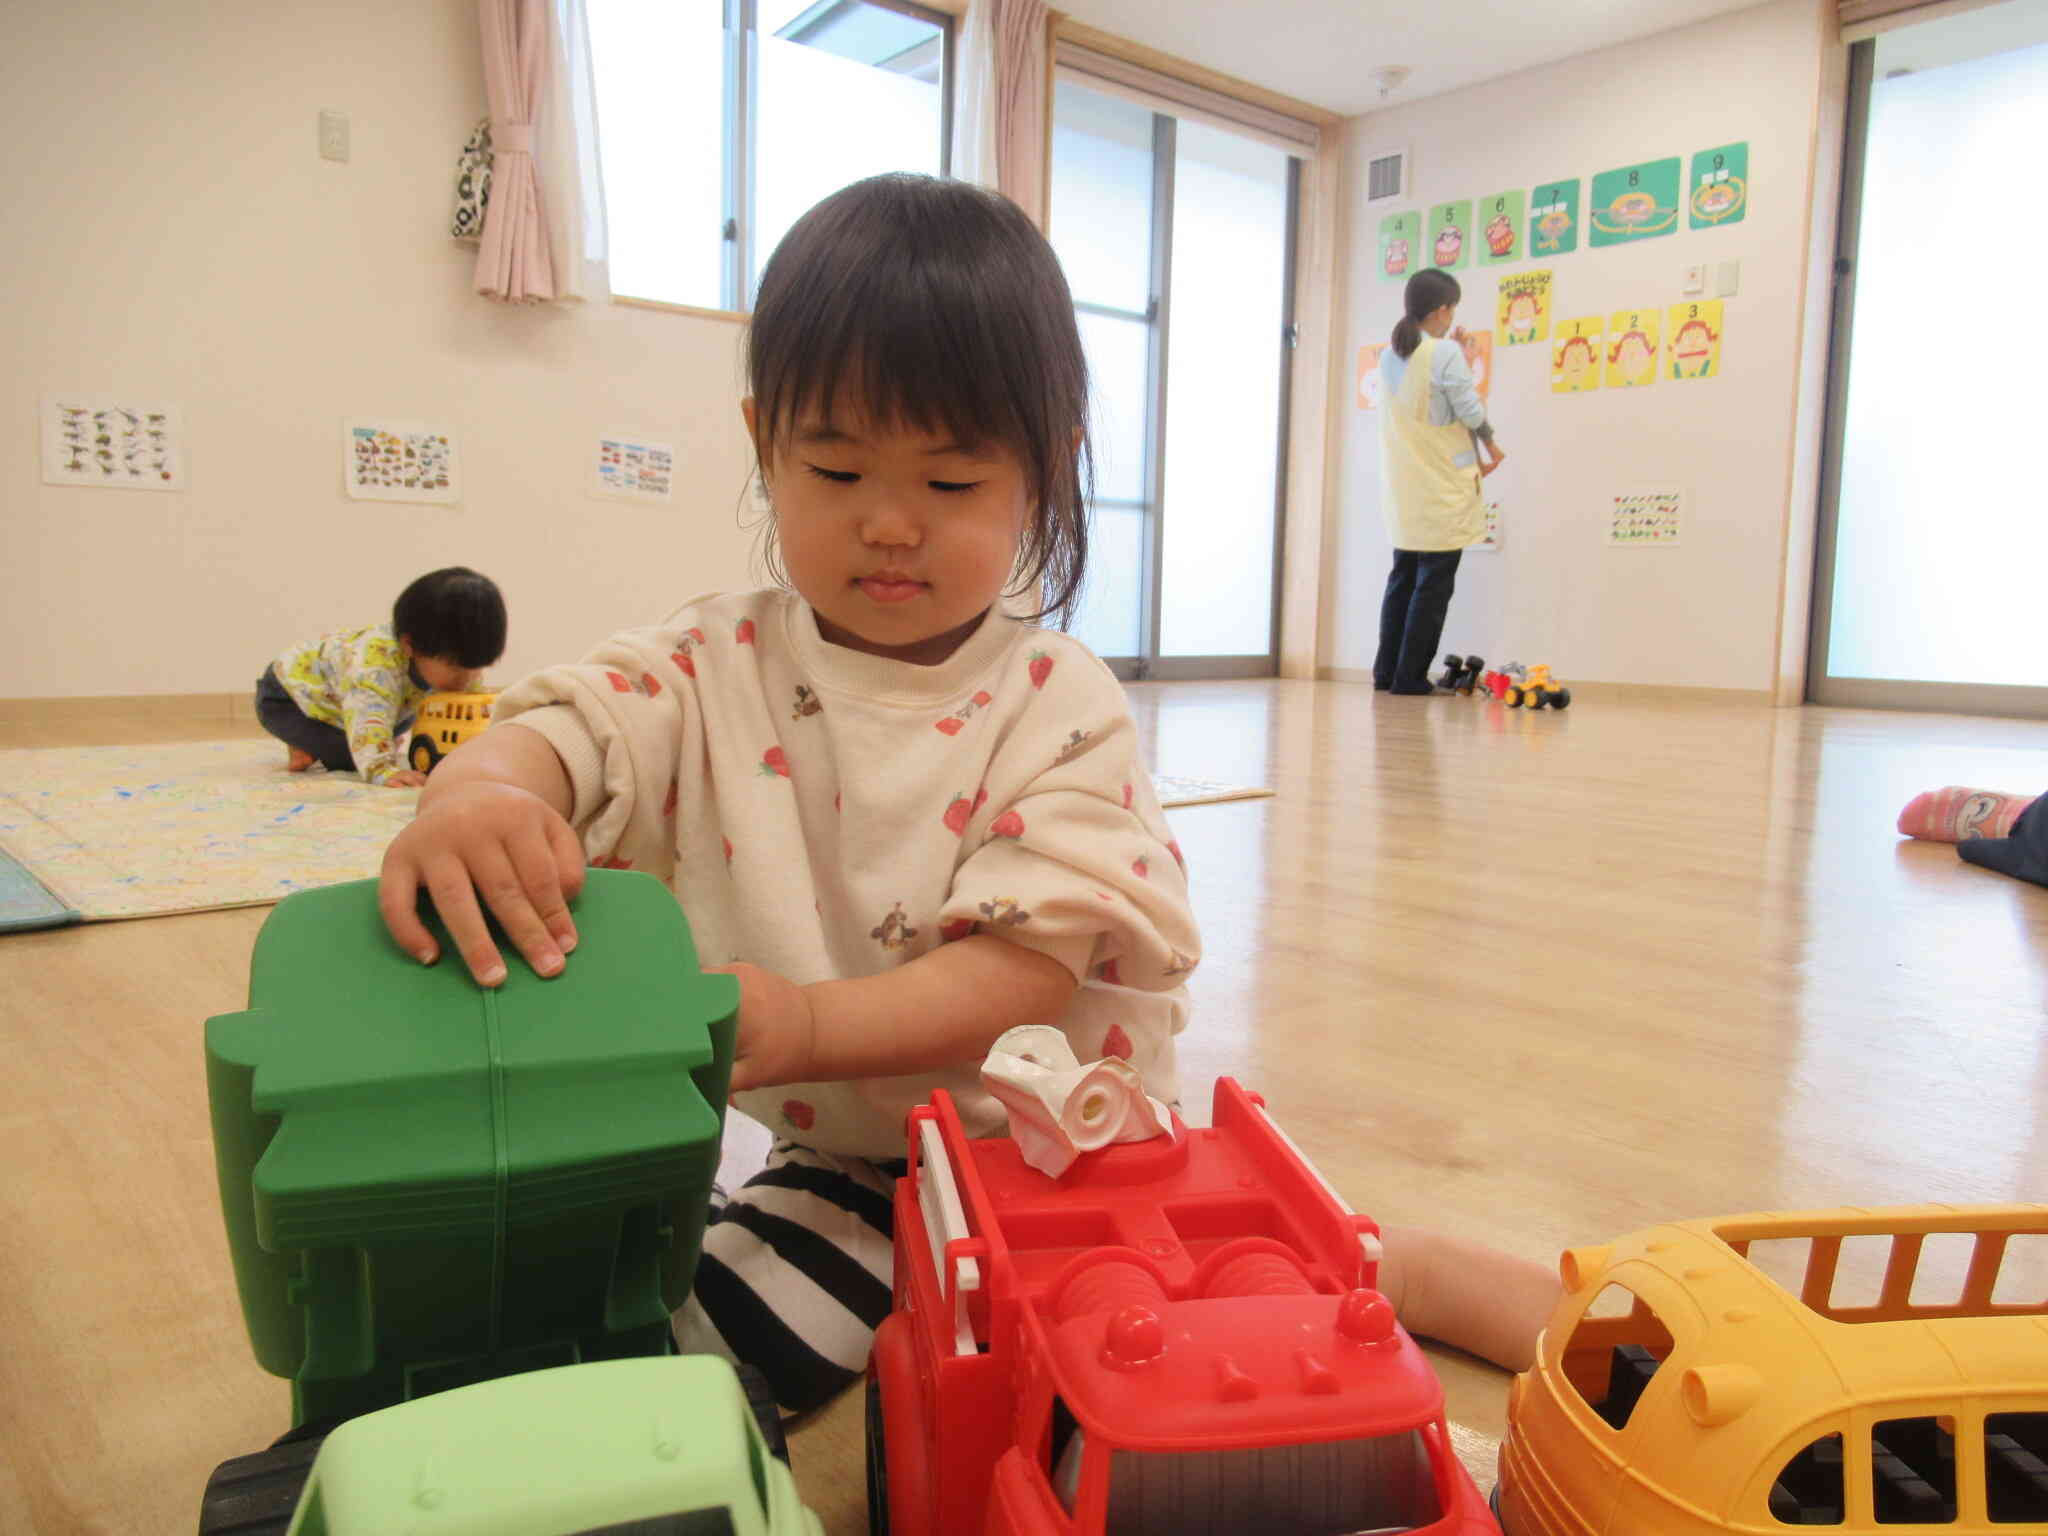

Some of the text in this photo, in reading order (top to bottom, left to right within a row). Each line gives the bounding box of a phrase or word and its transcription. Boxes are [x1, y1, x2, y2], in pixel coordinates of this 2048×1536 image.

[1713, 153, 1725, 170] 9
[1628, 169, 1639, 187] 8
[1551, 189, 1560, 205] 7
[1495, 198, 1505, 213] 6
[1445, 207, 1454, 222] 5
[1688, 304, 1699, 319] 3
[1575, 321, 1580, 335] 1
[1631, 314, 1639, 328] 2
